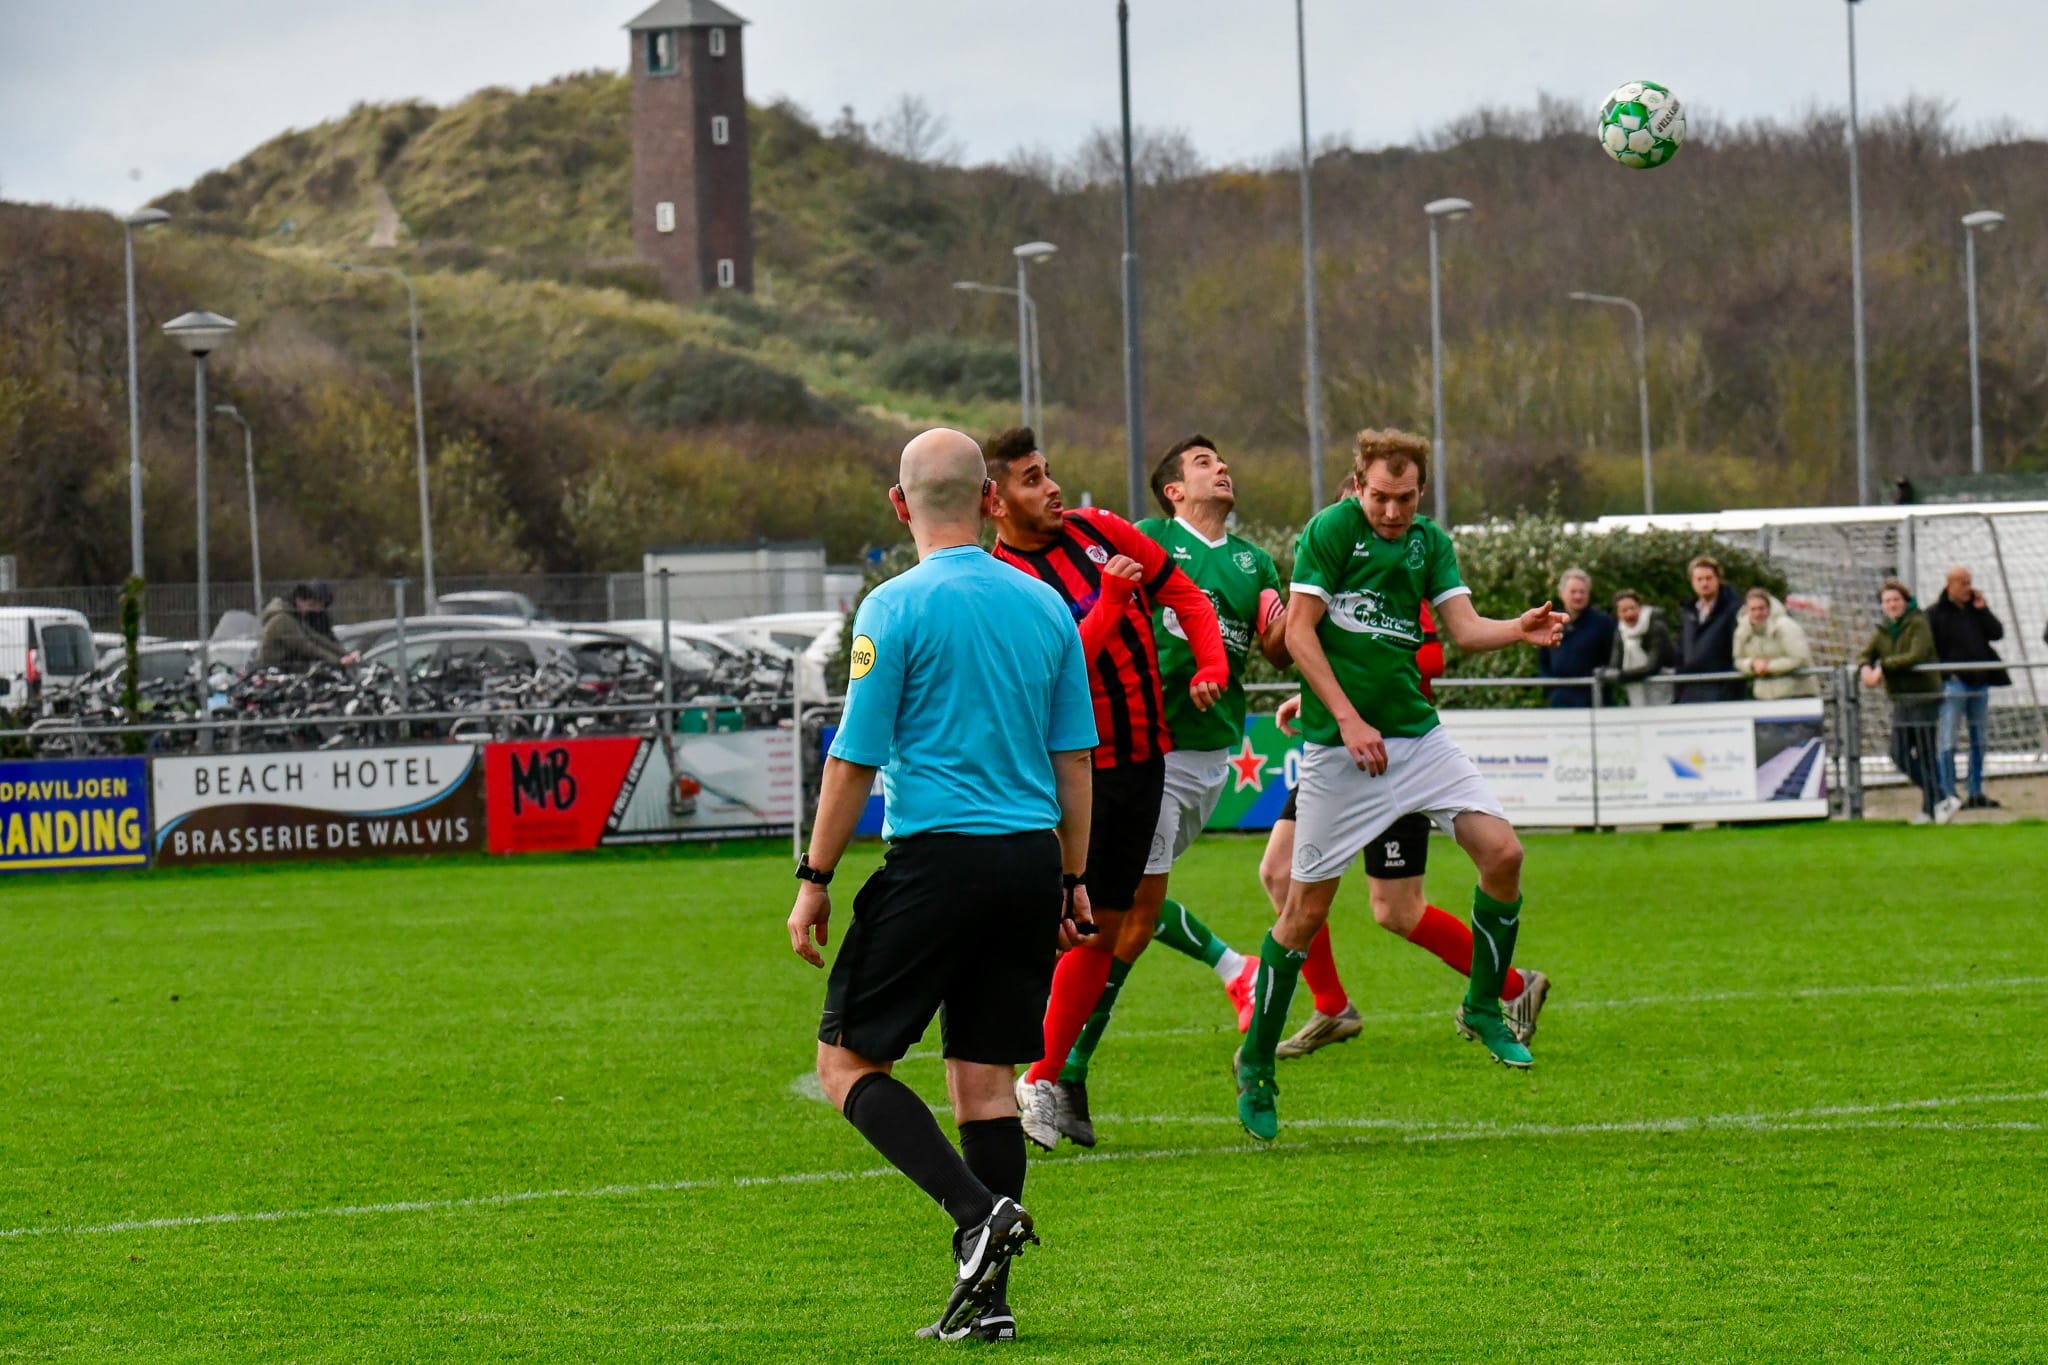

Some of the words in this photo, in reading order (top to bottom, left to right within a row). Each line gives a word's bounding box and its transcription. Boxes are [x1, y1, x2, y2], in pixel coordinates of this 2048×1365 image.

[195, 763, 303, 795] BEACH
[333, 758, 440, 790] HOTEL
[0, 807, 141, 855] ANDING
[174, 823, 320, 856] BRASSERIE
[327, 821, 360, 848] DE
[368, 817, 469, 846] WALVIS
[1384, 841, 1401, 859] 12
